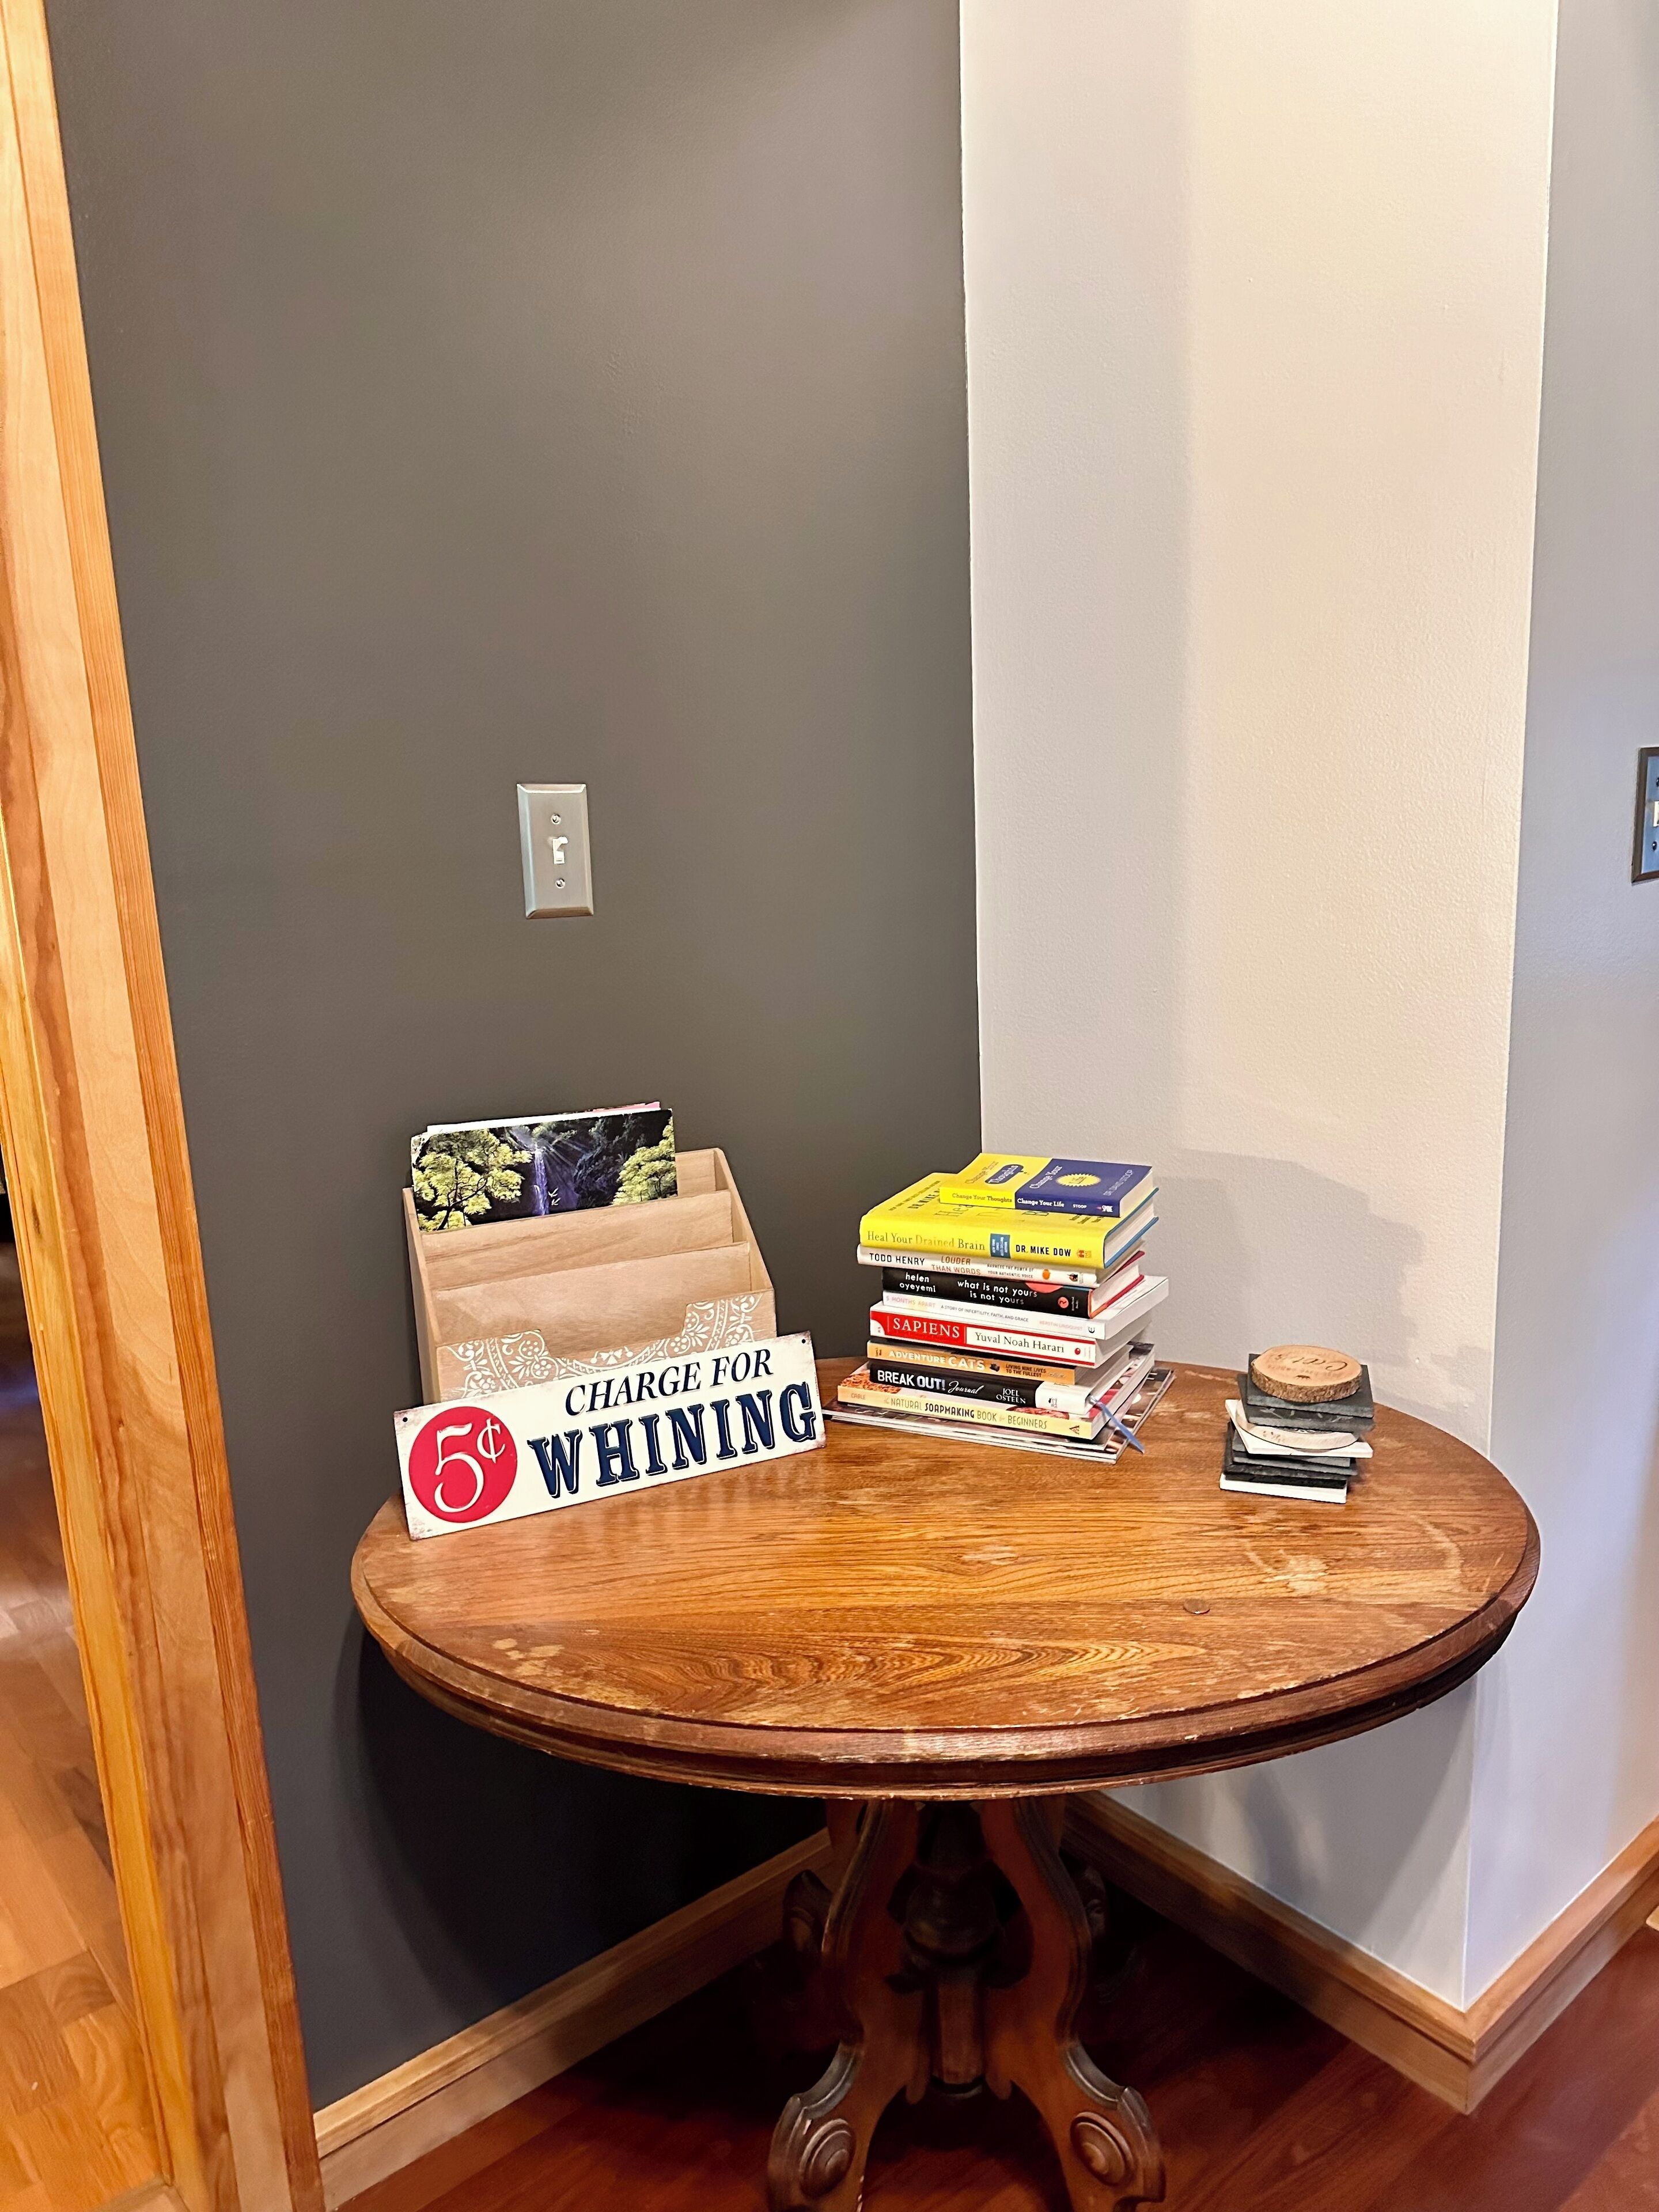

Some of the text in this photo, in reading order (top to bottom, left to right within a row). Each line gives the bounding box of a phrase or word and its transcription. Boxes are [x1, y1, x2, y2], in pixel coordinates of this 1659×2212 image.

[988, 1165, 1018, 1183] Thoughts
[1029, 1173, 1053, 1188] Change
[1017, 1198, 1039, 1206] Change
[868, 1230, 888, 1242] Heal
[891, 1232, 912, 1244] Your
[916, 1235, 954, 1247] Drained
[958, 1238, 985, 1251] Brain
[1031, 1246, 1050, 1255] MIKE
[1054, 1248, 1071, 1257] DOW
[869, 1253, 925, 1266] TODD HENRY
[941, 1256, 971, 1265] LOUDER
[906, 1272, 929, 1283] helen
[954, 1266, 981, 1275] WORDS
[899, 1282, 936, 1293] oyeyemi
[957, 1280, 1037, 1297] what is not yours
[892, 1297, 916, 1305] MONTHS
[918, 1299, 936, 1308] APART
[969, 1290, 977, 1298] is
[999, 1296, 1025, 1305] yours
[893, 1317, 960, 1338] SAPIENS
[975, 1332, 1065, 1353] Yuval Noah Harari
[889, 1350, 946, 1364] ADVENTURE
[948, 1356, 986, 1371] CATS
[565, 1361, 700, 1416] CHARGE
[711, 1348, 774, 1387] FOR
[877, 1370, 984, 1394] BREAK OUT! Journal
[996, 1394, 1026, 1404] OSTEEN
[1002, 1388, 1020, 1397] JOEL
[891, 1398, 922, 1410] NATURAL
[925, 1403, 974, 1418] SOAPMAKING
[977, 1410, 997, 1422] BOOK
[1007, 1415, 1047, 1430] BEGINNERS
[527, 1381, 817, 1499] WHINING
[434, 1418, 506, 1513] 5¢
